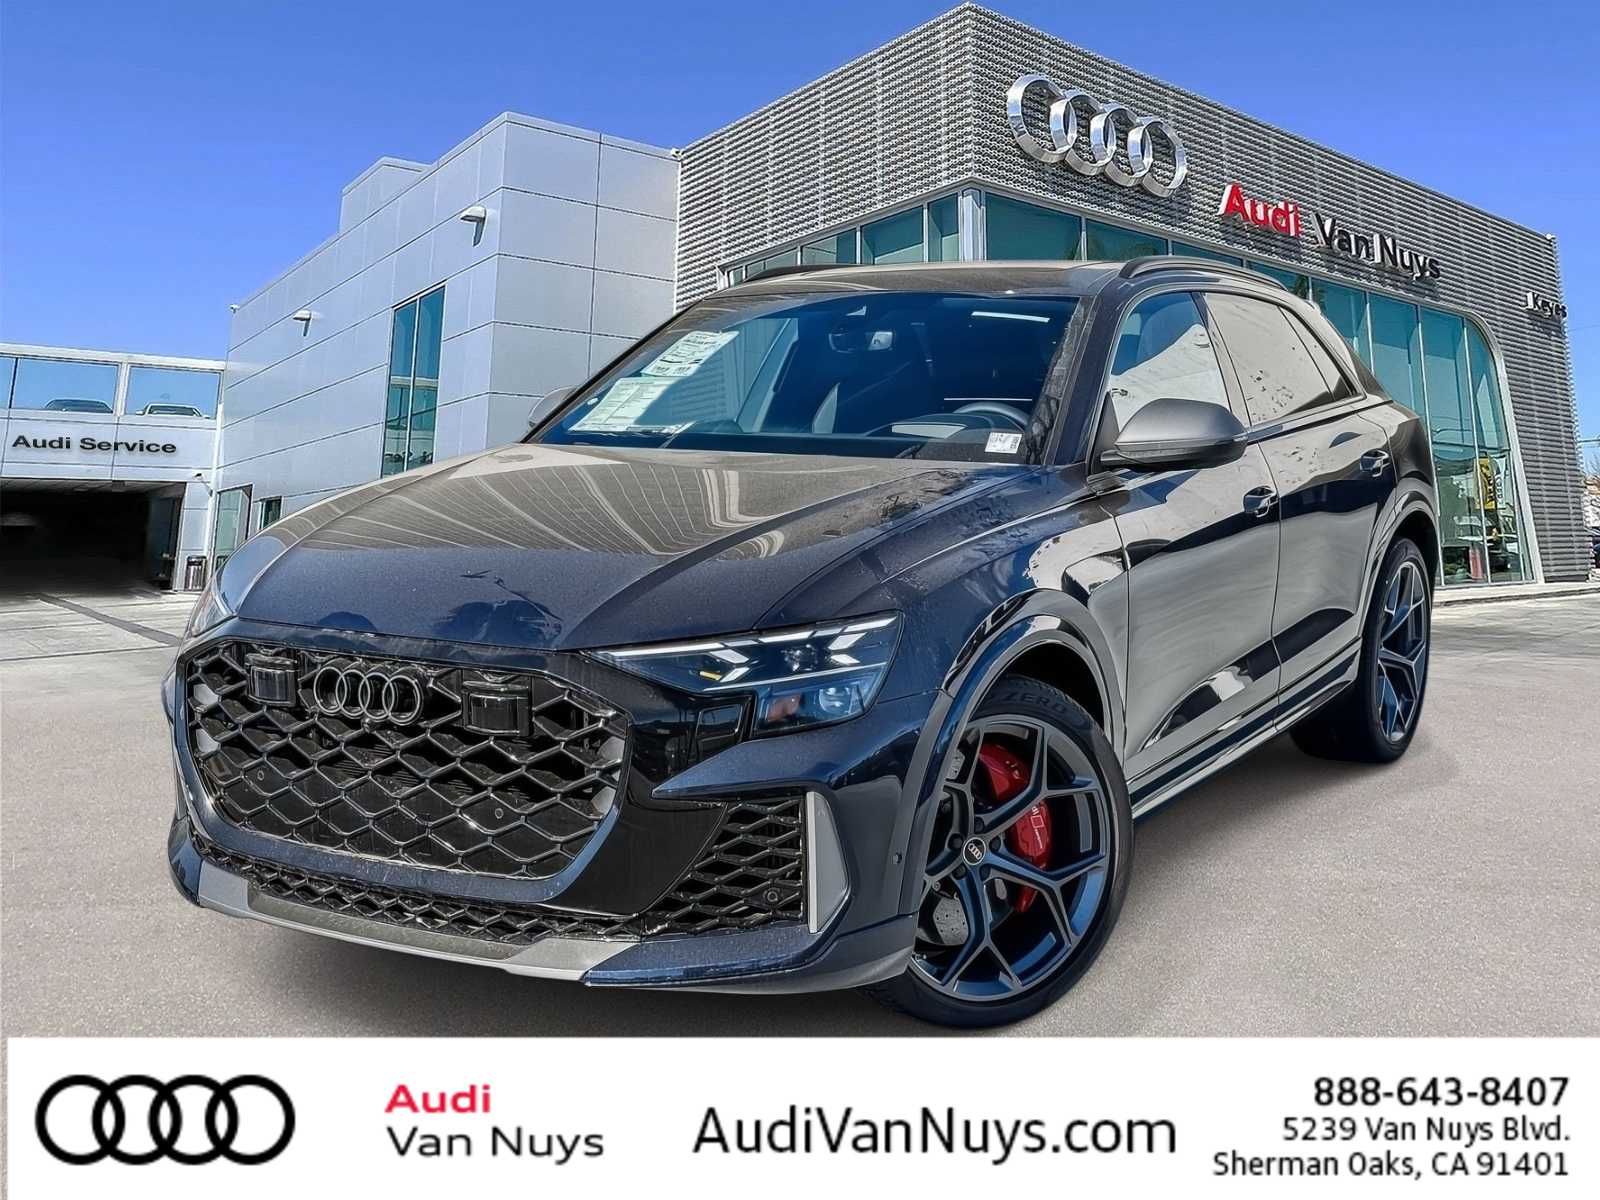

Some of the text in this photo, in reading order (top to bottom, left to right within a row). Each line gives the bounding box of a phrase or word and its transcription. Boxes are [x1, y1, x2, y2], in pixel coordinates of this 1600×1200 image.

[1216, 183, 1441, 280] Audi Van Nuys
[12, 435, 177, 453] Audi Service
